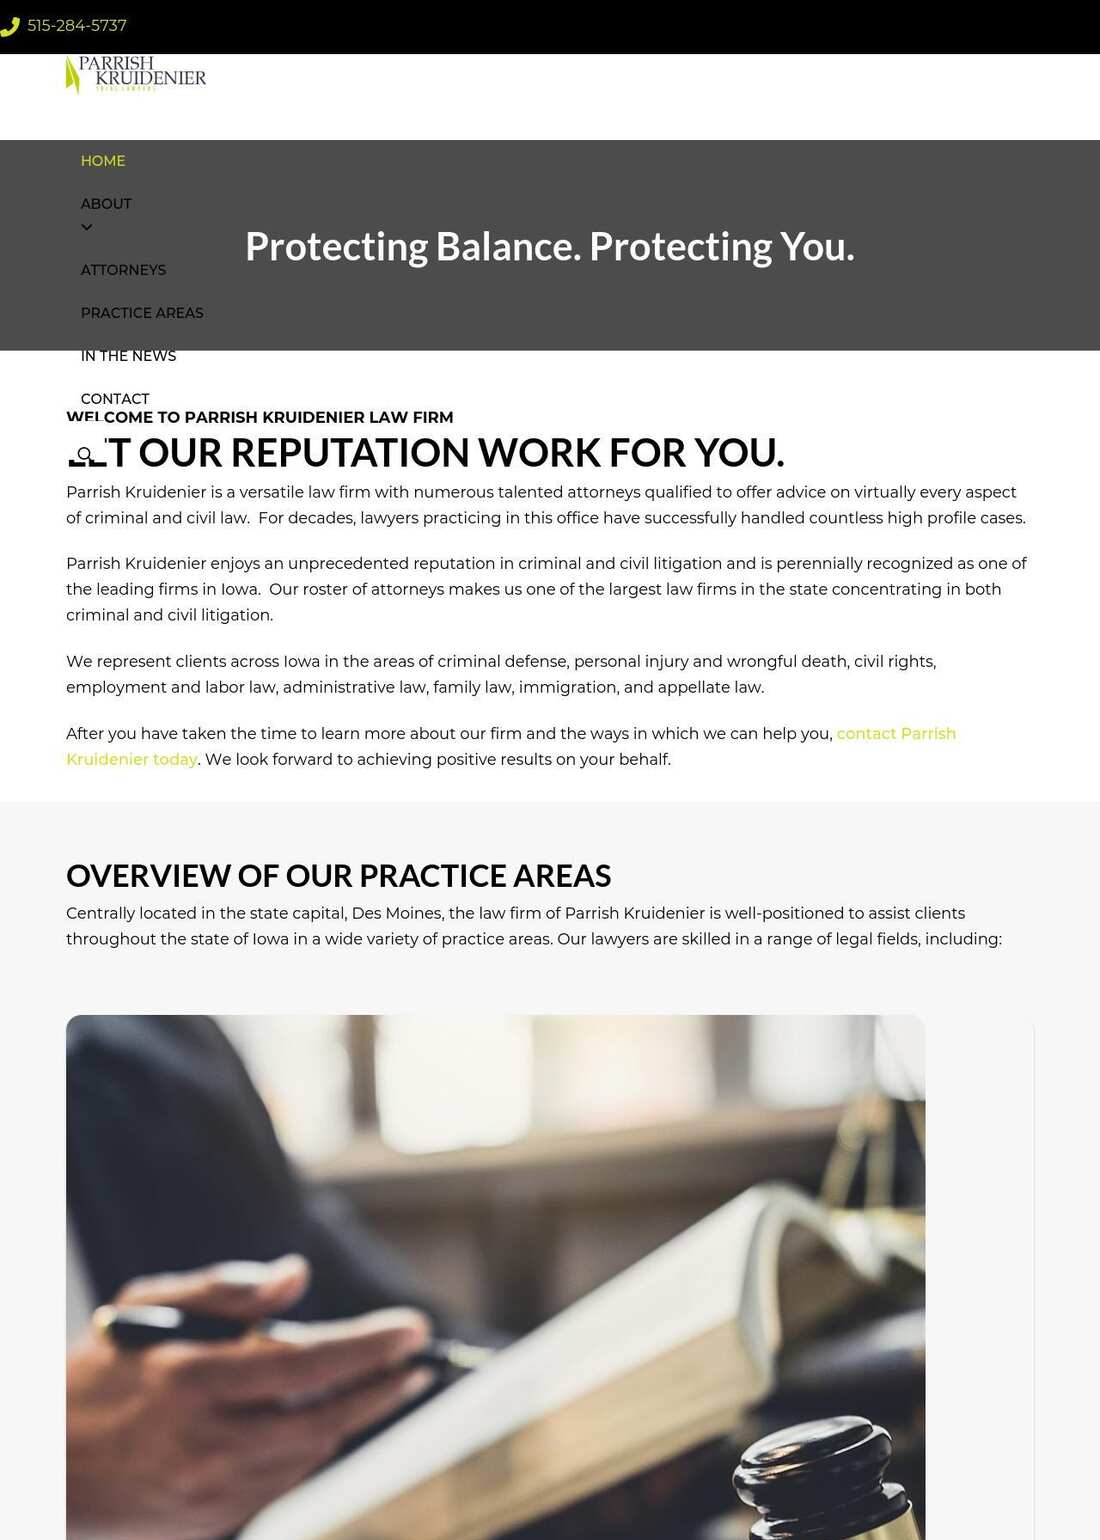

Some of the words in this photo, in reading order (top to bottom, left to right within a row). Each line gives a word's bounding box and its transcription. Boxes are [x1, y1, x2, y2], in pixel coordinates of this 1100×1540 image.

[27, 18, 128, 32] 515-284-5737
[79, 55, 154, 71] PARRISH
[96, 70, 207, 86] KRUIDENIER
[81, 154, 126, 168] HOME
[80, 197, 133, 210] ABOUT
[247, 230, 429, 269] Protecting
[437, 230, 581, 262] Balance.
[591, 230, 773, 269] Protecting
[779, 231, 855, 262] You.
[79, 263, 167, 276] ATTORNEYS
[81, 306, 153, 319] PRACTICE
[155, 306, 204, 319] AREAS
[81, 350, 96, 362] IN
[99, 350, 129, 362] THE
[132, 350, 177, 362] NEWS
[80, 392, 151, 406] CONTACT
[66, 410, 154, 424] WELCOME
[156, 410, 181, 424] TO
[184, 410, 258, 424] PARRISH
[262, 410, 365, 424] KRUIDENIER
[369, 410, 409, 424] LAW
[413, 410, 454, 424] FIRM
[139, 437, 223, 468] OUR
[232, 437, 469, 468] REPUTATION
[477, 437, 602, 468] WORK
[610, 437, 687, 468] FOR
[693, 437, 785, 468] YOU.
[66, 484, 121, 499] Parrish
[125, 484, 208, 499] Kruidenier
[210, 484, 223, 499] is
[224, 488, 236, 499] a
[237, 484, 305, 499] versatile
[308, 484, 336, 499] law
[338, 484, 371, 499] firm
[374, 484, 410, 499] with
[414, 487, 495, 502] numerous
[497, 484, 563, 499] talented
[567, 486, 642, 502] attorneys
[644, 484, 712, 502] qualified
[715, 486, 733, 499] to
[736, 484, 773, 499] offer
[776, 484, 827, 499] advice
[830, 488, 850, 499] on
[853, 484, 917, 502] virtually
[919, 488, 962, 502] every
[965, 486, 1018, 502] aspect
[66, 607, 129, 622] criminal
[133, 607, 163, 622] and
[167, 607, 197, 622] civil
[201, 607, 274, 625] litigation.
[66, 655, 93, 668] We
[97, 655, 172, 671] represent
[175, 653, 227, 668] clients
[230, 657, 280, 668] across
[284, 655, 320, 668] Iowa
[324, 653, 339, 668] in
[342, 654, 370, 668] the
[373, 657, 415, 668] areas
[418, 653, 435, 668] of
[437, 653, 501, 668] criminal
[504, 653, 570, 670] defense,
[574, 653, 641, 671] personal
[645, 654, 690, 672] injury
[692, 654, 723, 668] and
[726, 653, 797, 672] wrongful
[801, 653, 851, 670] death,
[854, 653, 884, 668] civil
[888, 653, 937, 672] rights,
[66, 752, 149, 767] Kruidenier
[153, 752, 201, 769] today.
[205, 752, 232, 766] We
[236, 751, 269, 766] look
[271, 751, 333, 766] forward
[336, 753, 354, 766] to
[357, 752, 432, 770] achieving
[436, 752, 497, 769] positive
[501, 752, 553, 766] results
[555, 755, 576, 766] on
[579, 755, 616, 770] your
[619, 752, 671, 766] behalf.
[66, 863, 233, 888] OVERVIEW
[238, 863, 280, 888] OF
[286, 863, 353, 888] OUR
[360, 863, 507, 888] PRACTICE
[512, 863, 612, 888] AREAS
[66, 905, 136, 923] Centrally
[139, 905, 197, 920] located
[201, 905, 216, 920] in
[219, 906, 246, 920] the
[249, 907, 289, 920] state
[292, 905, 348, 923] capital,
[352, 906, 382, 920] Des
[386, 906, 445, 922] Moines,
[448, 905, 475, 920] the
[479, 906, 507, 920] law
[509, 905, 542, 920] firm
[545, 905, 562, 920] of
[565, 905, 620, 920] Parrish
[624, 905, 706, 920] Kruidenier
[709, 905, 722, 920] is
[724, 905, 844, 923] well-positioned
[848, 907, 865, 920] to
[868, 905, 911, 920] assist
[914, 905, 966, 920] clients
